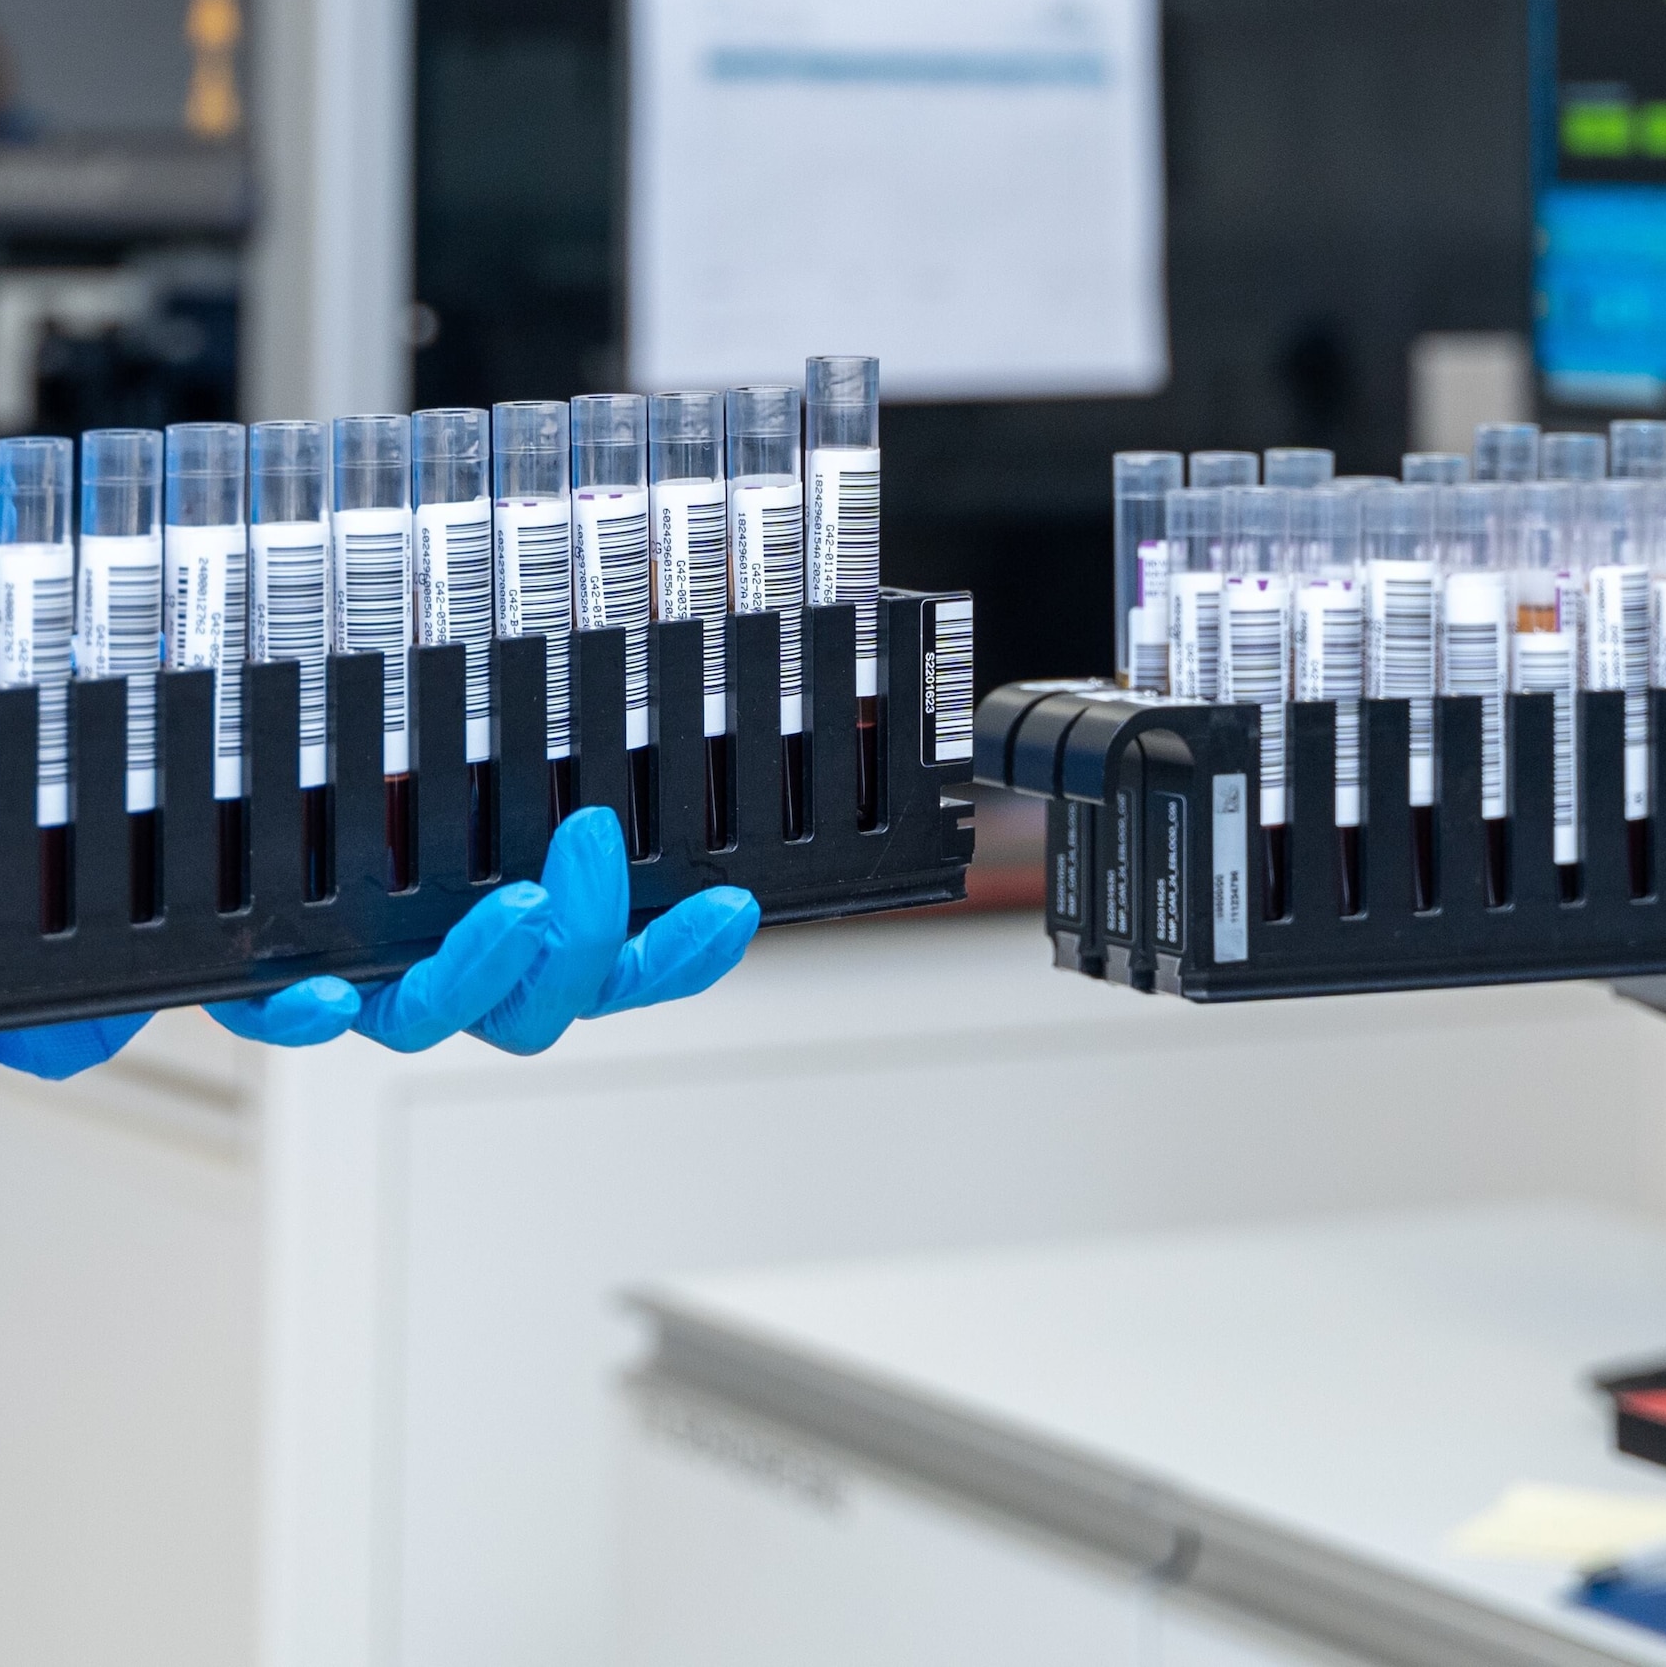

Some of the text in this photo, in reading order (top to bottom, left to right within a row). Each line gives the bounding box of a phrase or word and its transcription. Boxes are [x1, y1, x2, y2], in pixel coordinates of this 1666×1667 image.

[662, 508, 673, 596] 60242960155A
[738, 513, 748, 599] 18242960157A
[813, 473, 824, 559] 18242960154A
[195, 557, 209, 635] 2400012762
[824, 524, 835, 604] G42-0114768
[337, 591, 345, 651] G42-0184
[925, 652, 935, 714] S2201623
